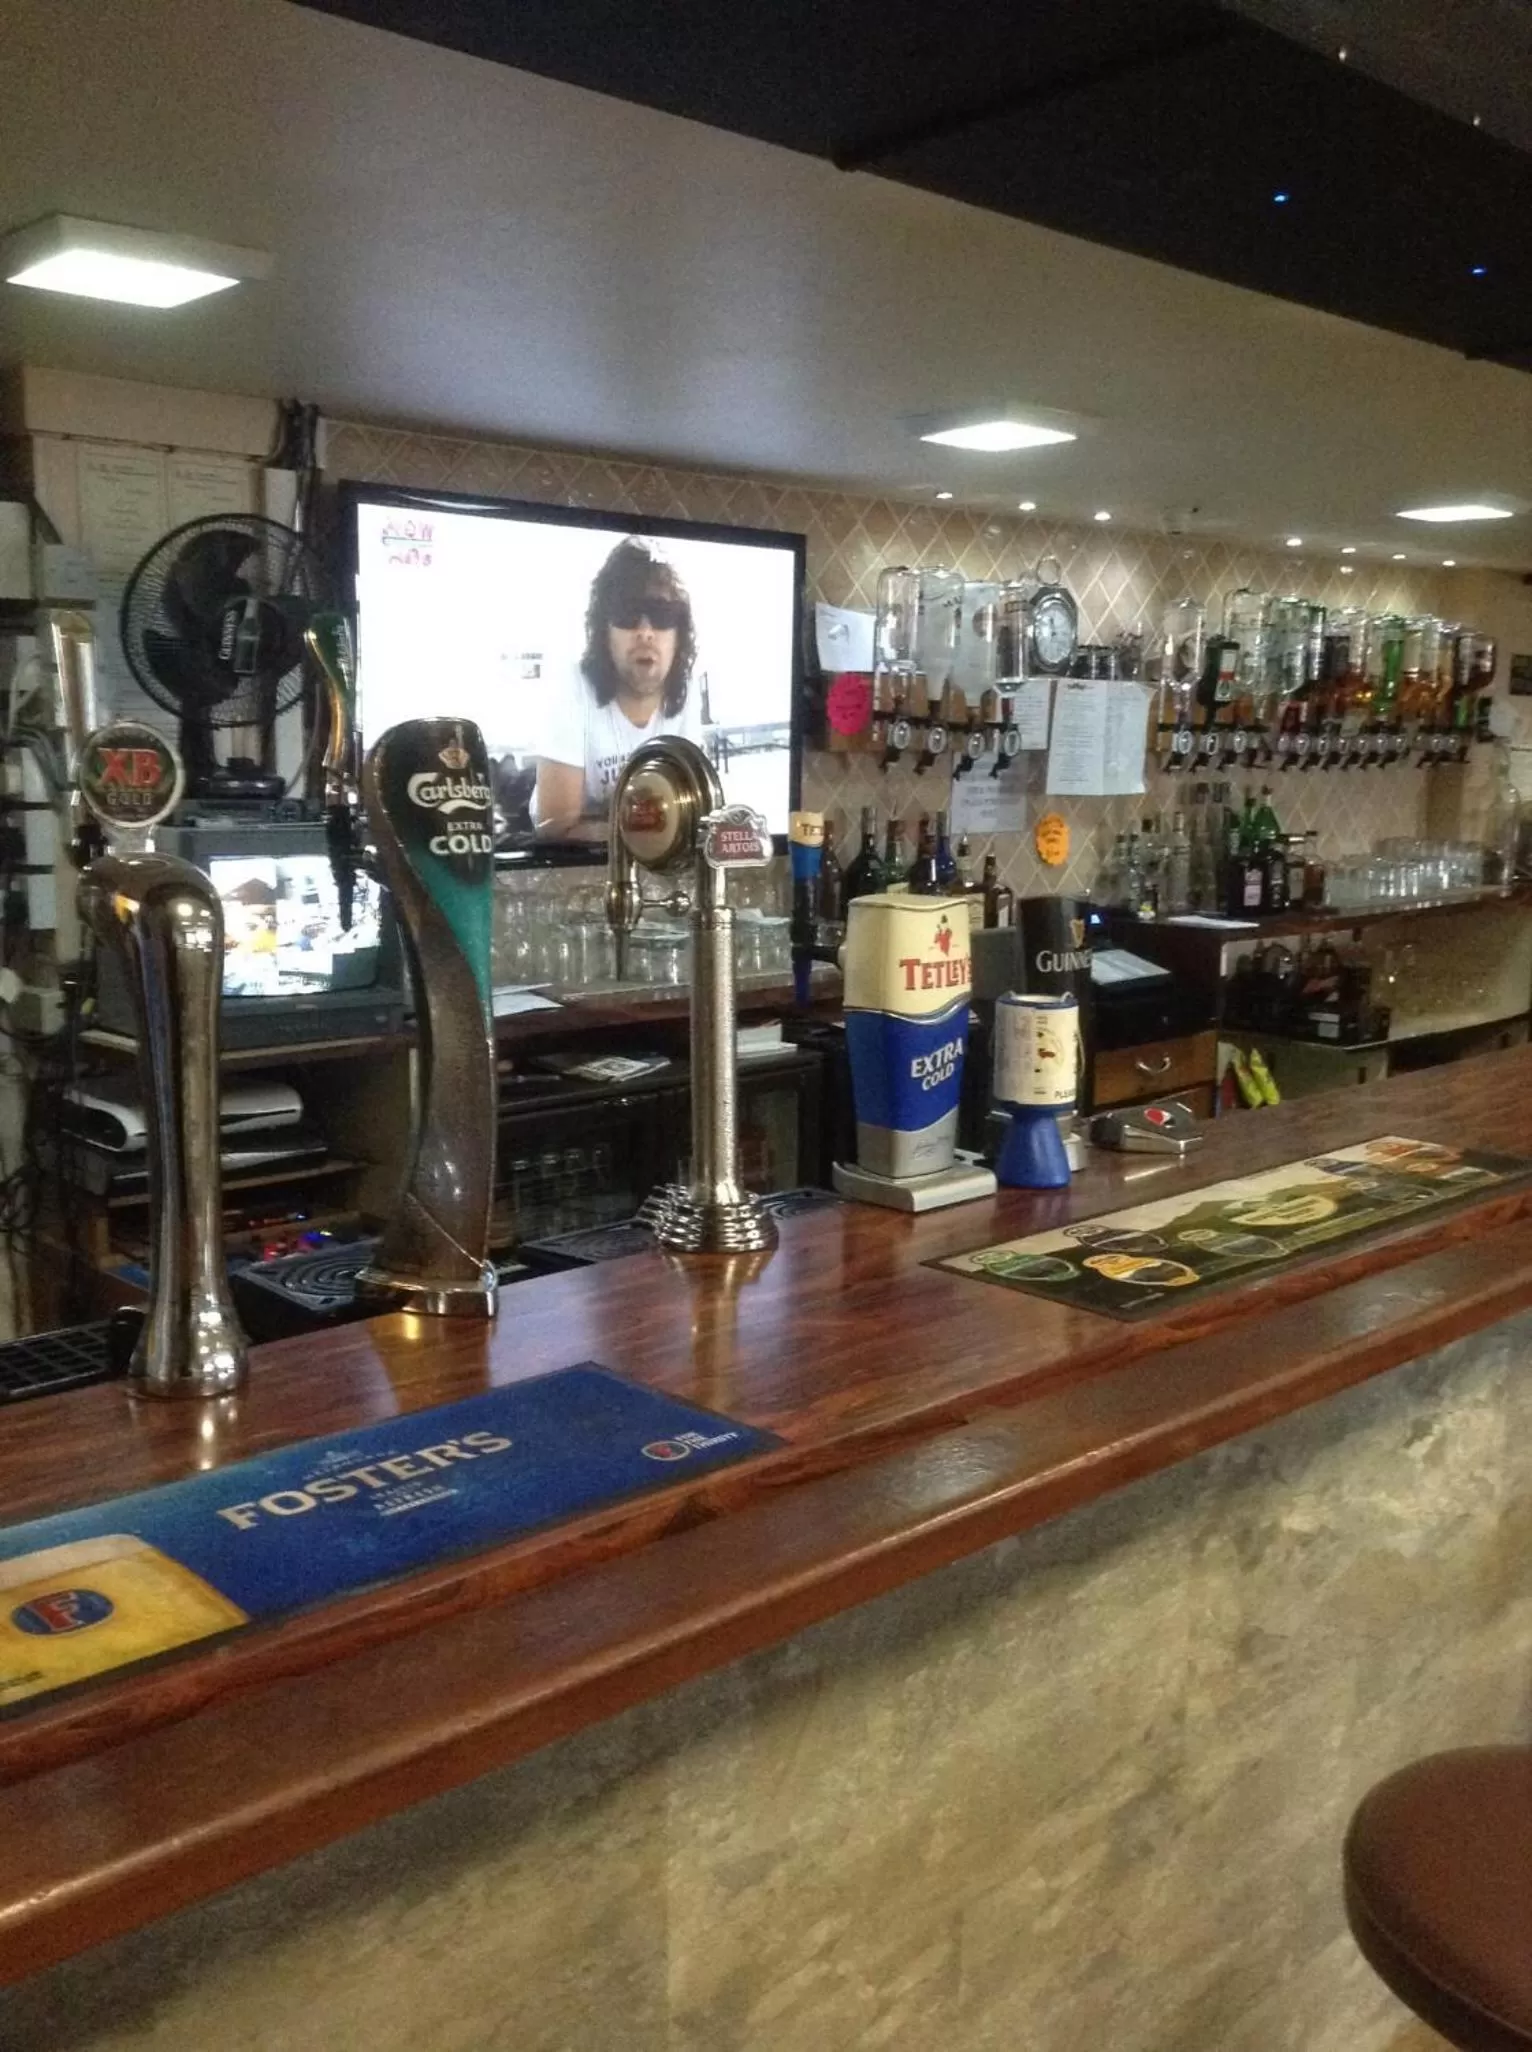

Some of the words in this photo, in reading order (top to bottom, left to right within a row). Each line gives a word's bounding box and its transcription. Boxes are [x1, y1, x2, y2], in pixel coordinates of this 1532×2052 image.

[97, 747, 161, 788] XB
[429, 834, 492, 855] COLD
[720, 831, 759, 842] STELLA
[721, 843, 761, 854] ARTOIS
[911, 1037, 964, 1078] EXTRA
[922, 1063, 954, 1091] COLD
[215, 1431, 513, 1530] FOSTER'S
